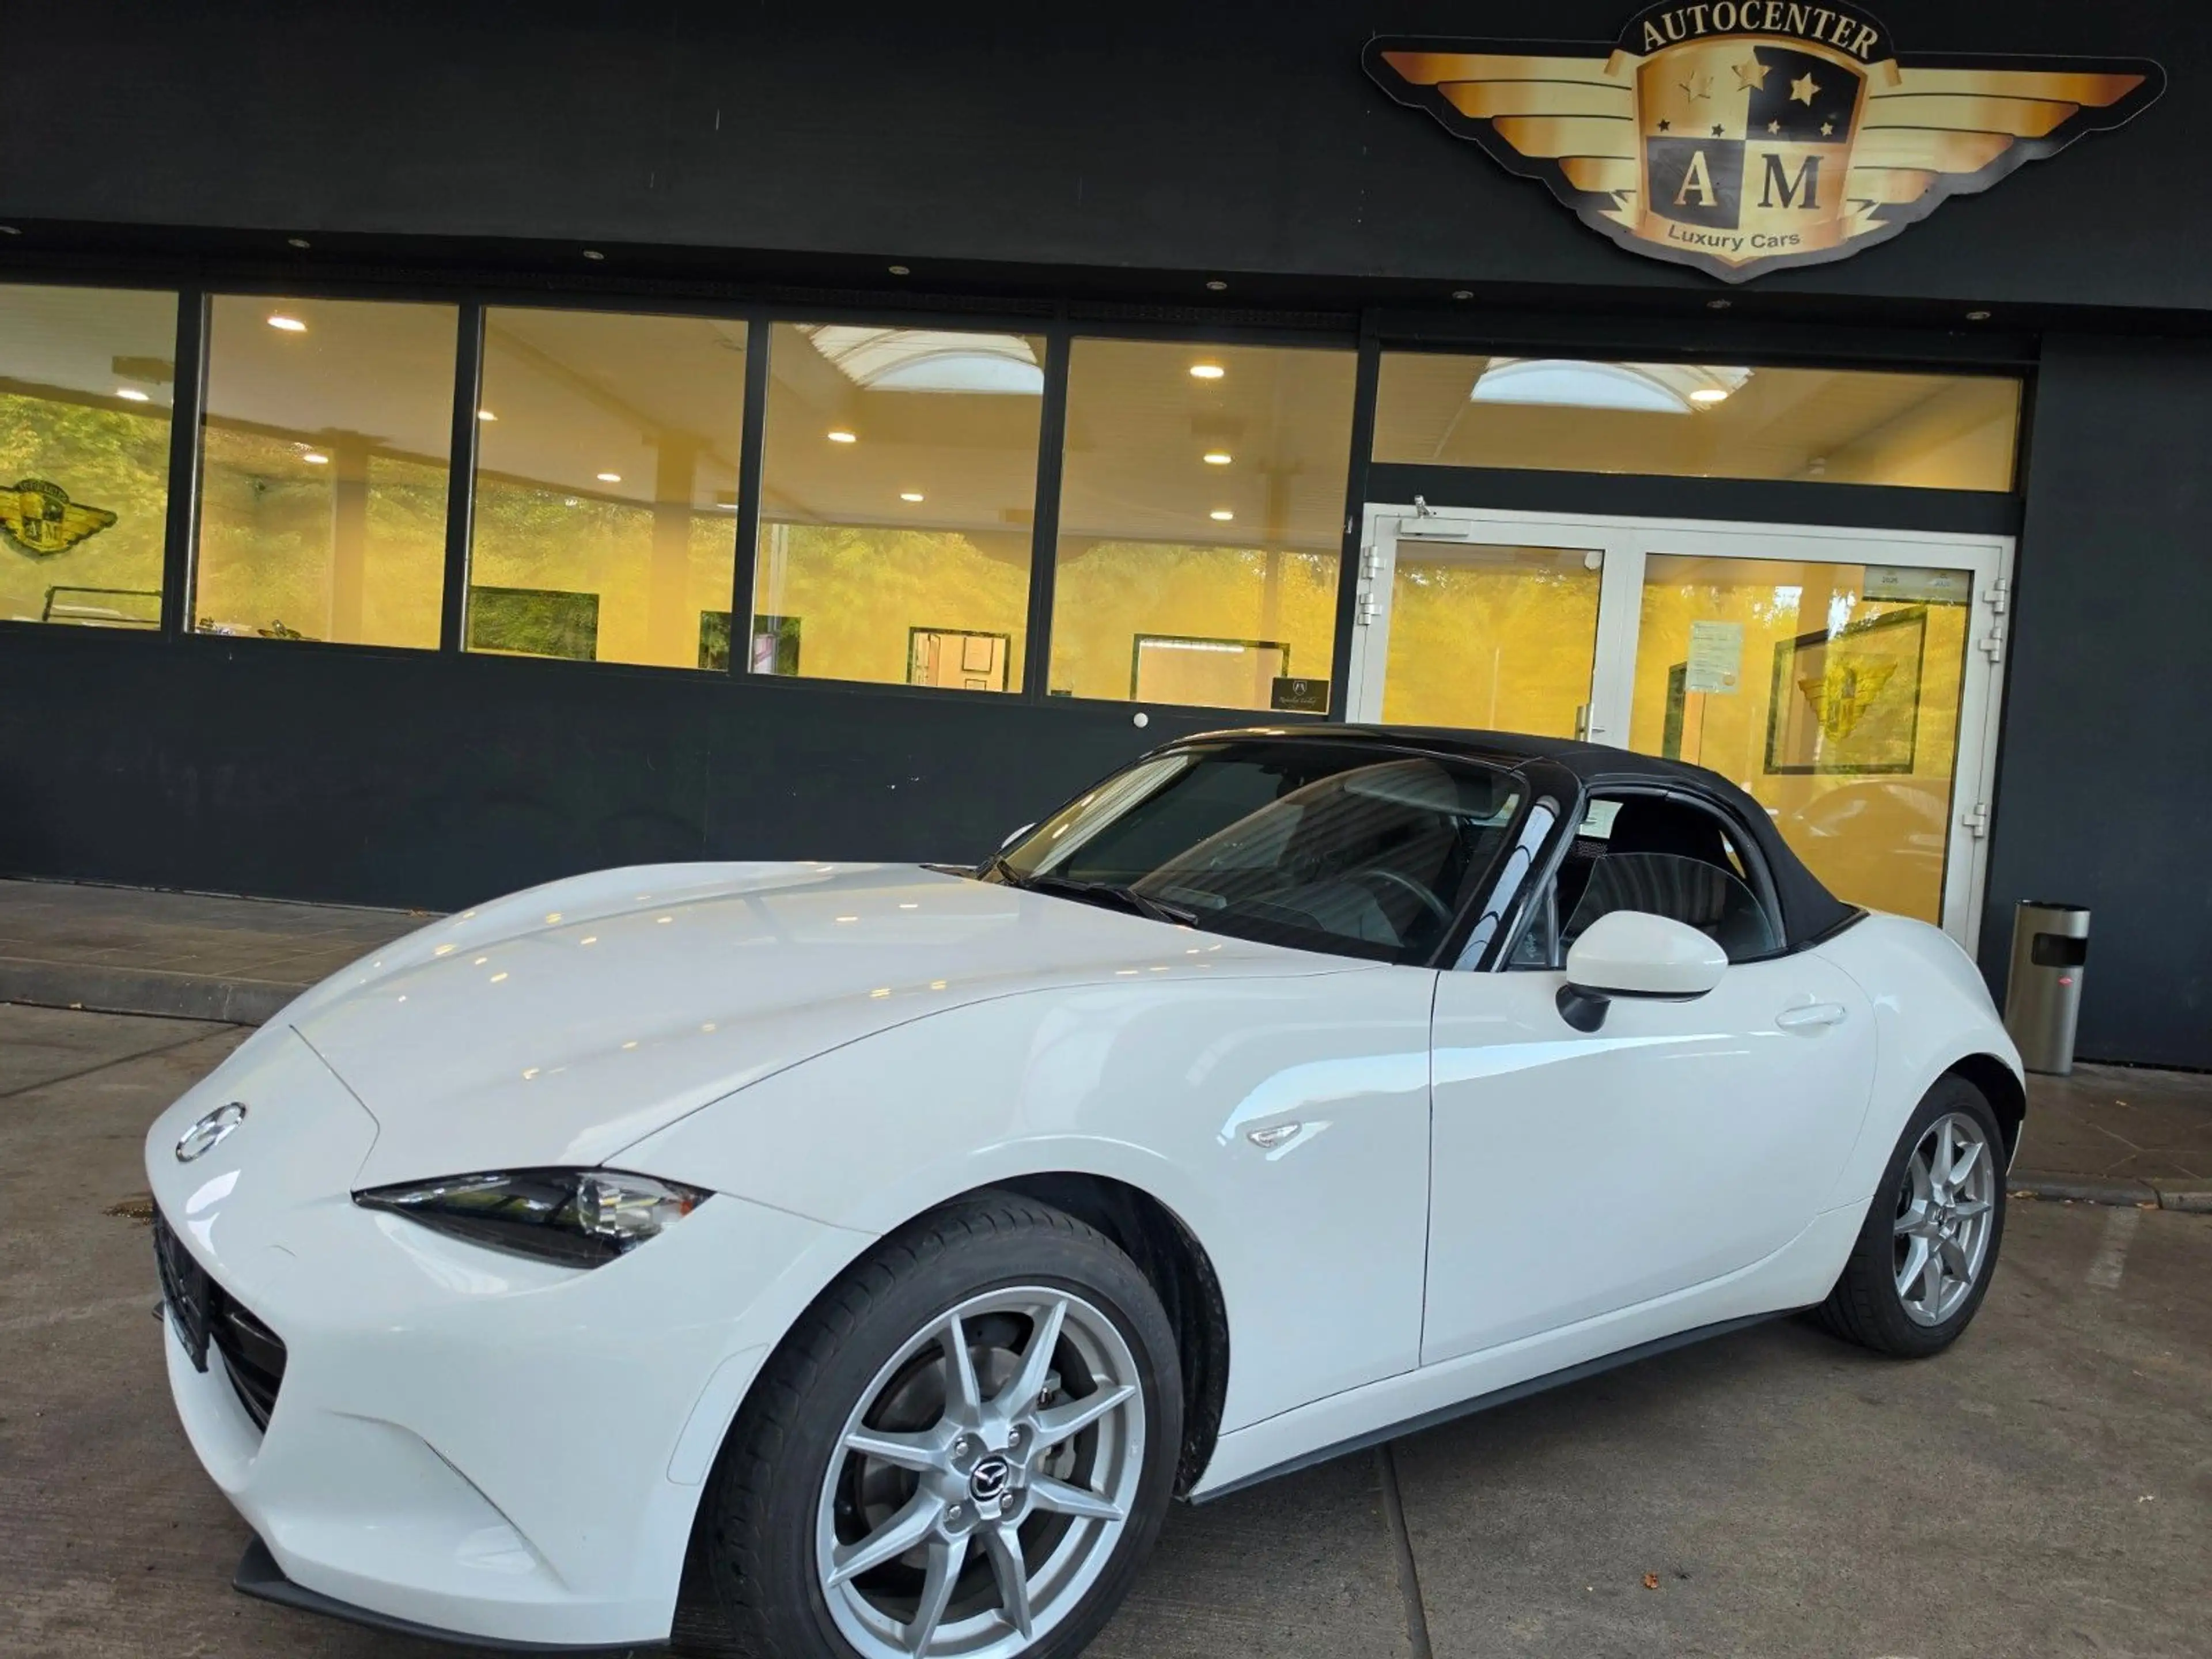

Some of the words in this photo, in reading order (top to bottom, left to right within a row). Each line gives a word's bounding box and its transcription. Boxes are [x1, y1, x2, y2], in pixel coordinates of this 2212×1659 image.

[1644, 1, 1878, 59] AUTOCENTER
[1673, 150, 1718, 207] A
[1757, 153, 1824, 210] M
[1668, 224, 1744, 251] Luxury
[1751, 233, 1801, 248] Cars
